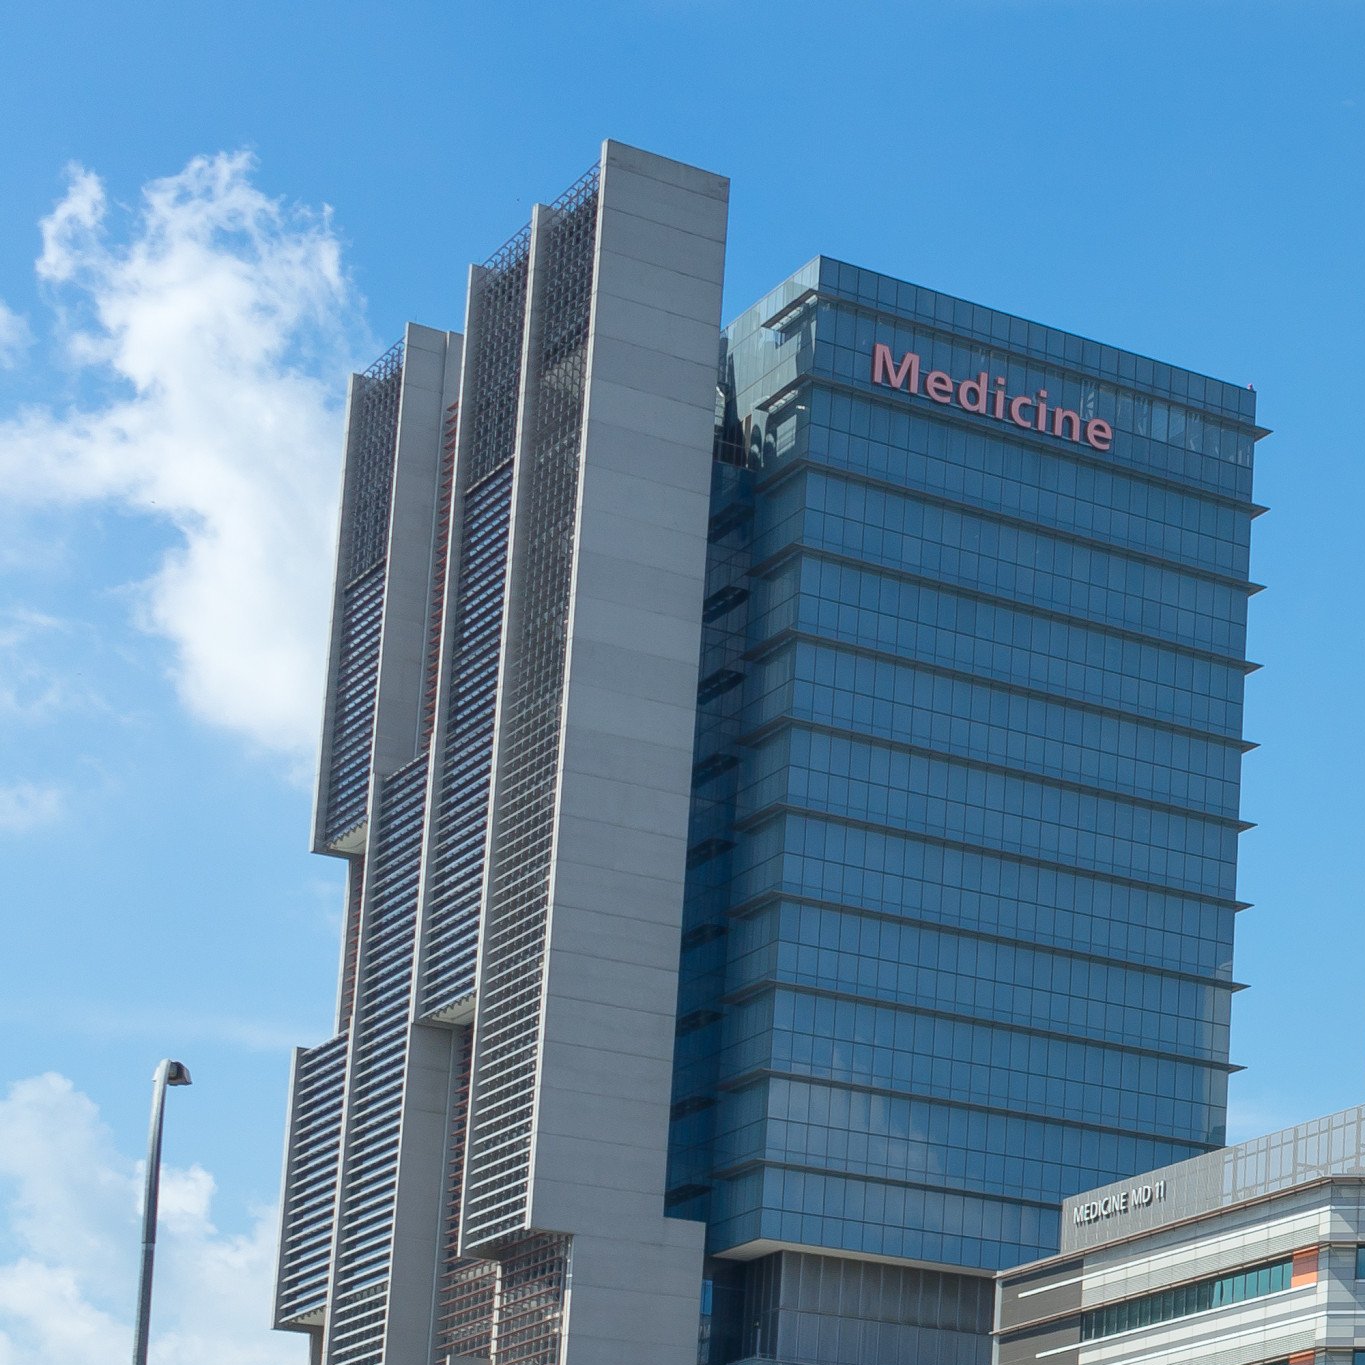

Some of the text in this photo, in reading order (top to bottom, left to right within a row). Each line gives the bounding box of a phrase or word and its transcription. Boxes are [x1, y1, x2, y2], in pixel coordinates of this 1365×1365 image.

[872, 343, 1114, 452] Medicine
[1073, 1180, 1166, 1224] MEDICINE MD 11
